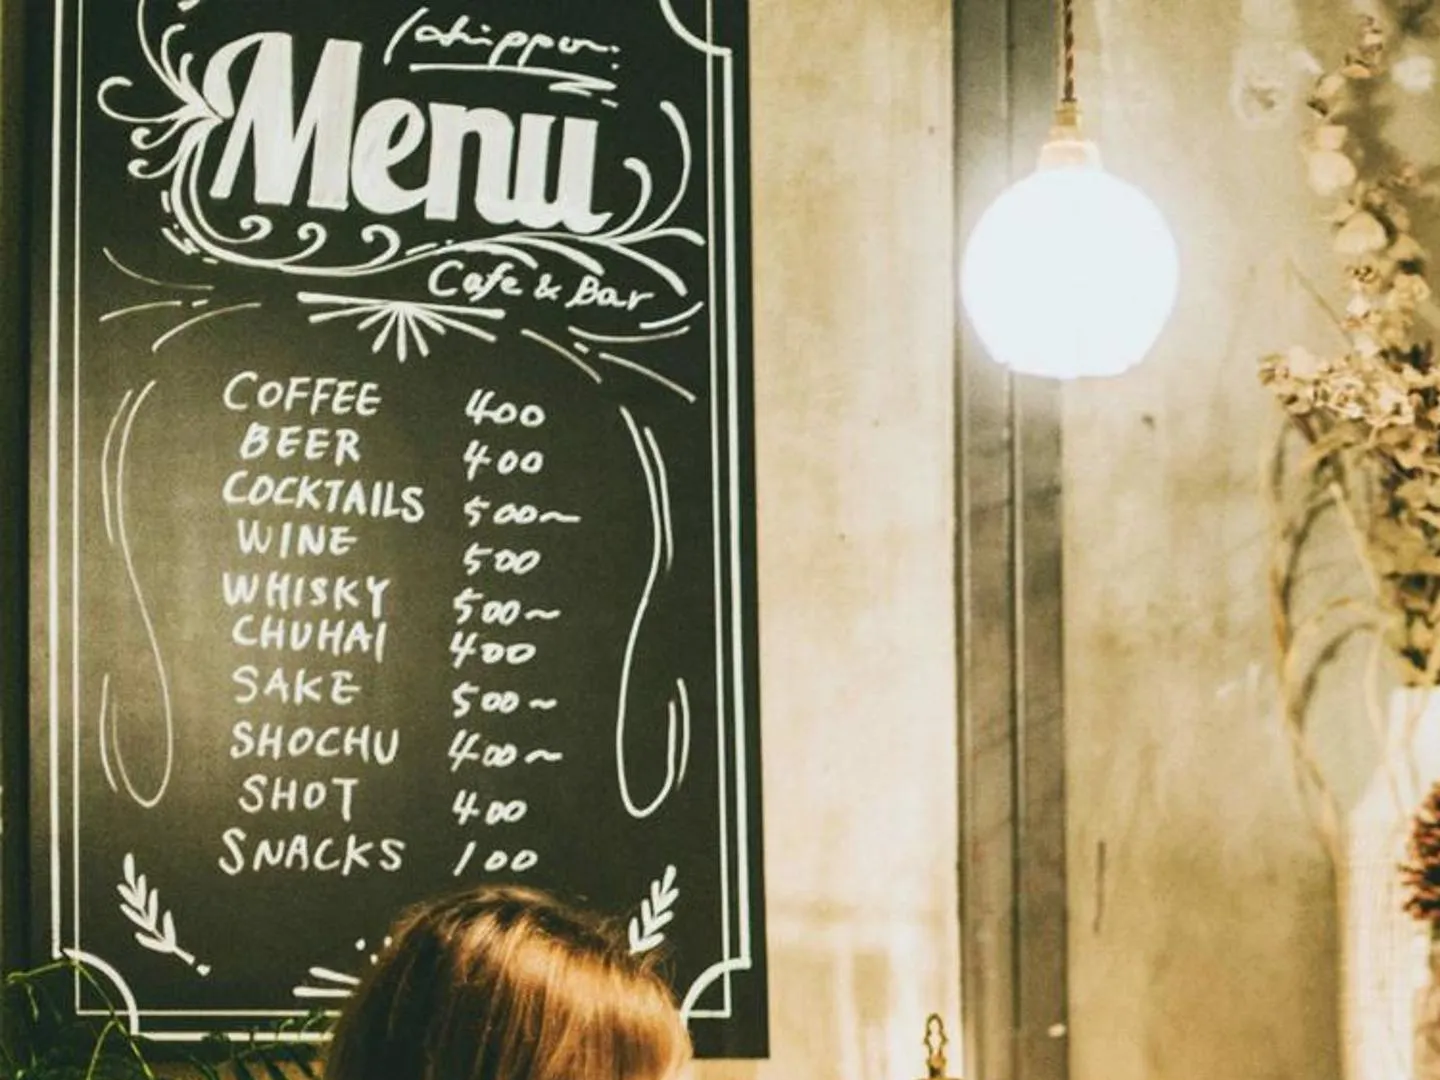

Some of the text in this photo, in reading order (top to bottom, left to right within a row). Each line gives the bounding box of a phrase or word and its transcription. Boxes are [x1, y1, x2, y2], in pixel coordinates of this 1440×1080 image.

[202, 31, 613, 233] Menu
[428, 258, 655, 311] Cafe & Bar
[222, 370, 546, 427] COFFEE 400
[239, 421, 545, 482] BEER 400
[222, 469, 426, 523] COCKTAILS
[237, 518, 541, 576] WINE 500
[222, 571, 391, 618] WHISKY
[231, 614, 537, 669] CHUHAI 400
[231, 664, 361, 705] SAKE
[229, 721, 399, 765] SHOCHU
[238, 774, 528, 826] SHOT 400
[218, 827, 539, 877] SNACKS 100
